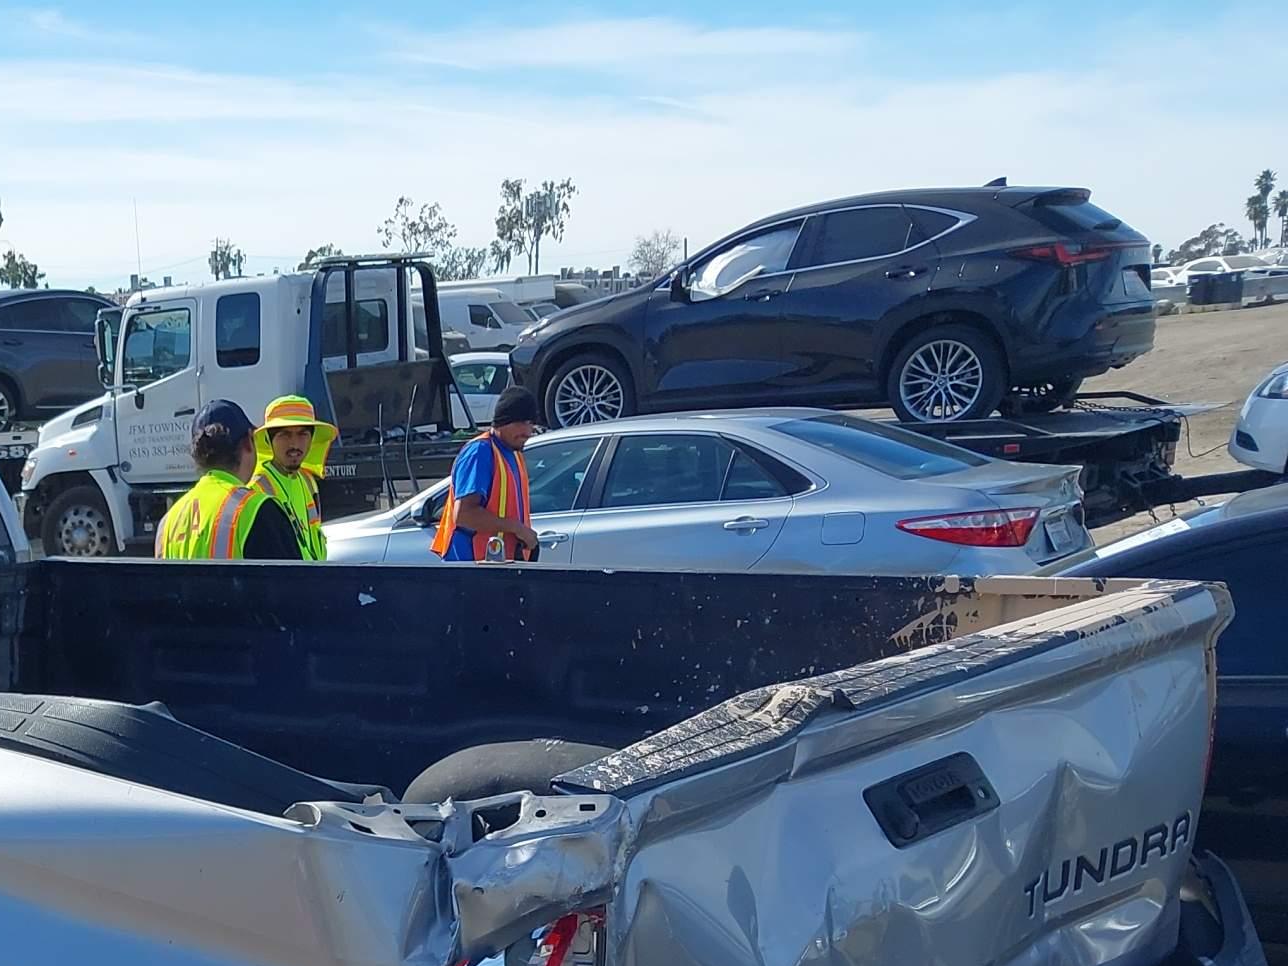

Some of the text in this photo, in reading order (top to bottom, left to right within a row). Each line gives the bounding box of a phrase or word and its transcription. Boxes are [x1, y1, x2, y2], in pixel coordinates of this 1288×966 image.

[128, 421, 190, 436] JFM TOWING
[325, 464, 357, 477] ENTURY
[1024, 811, 1192, 919] TUNDRA
